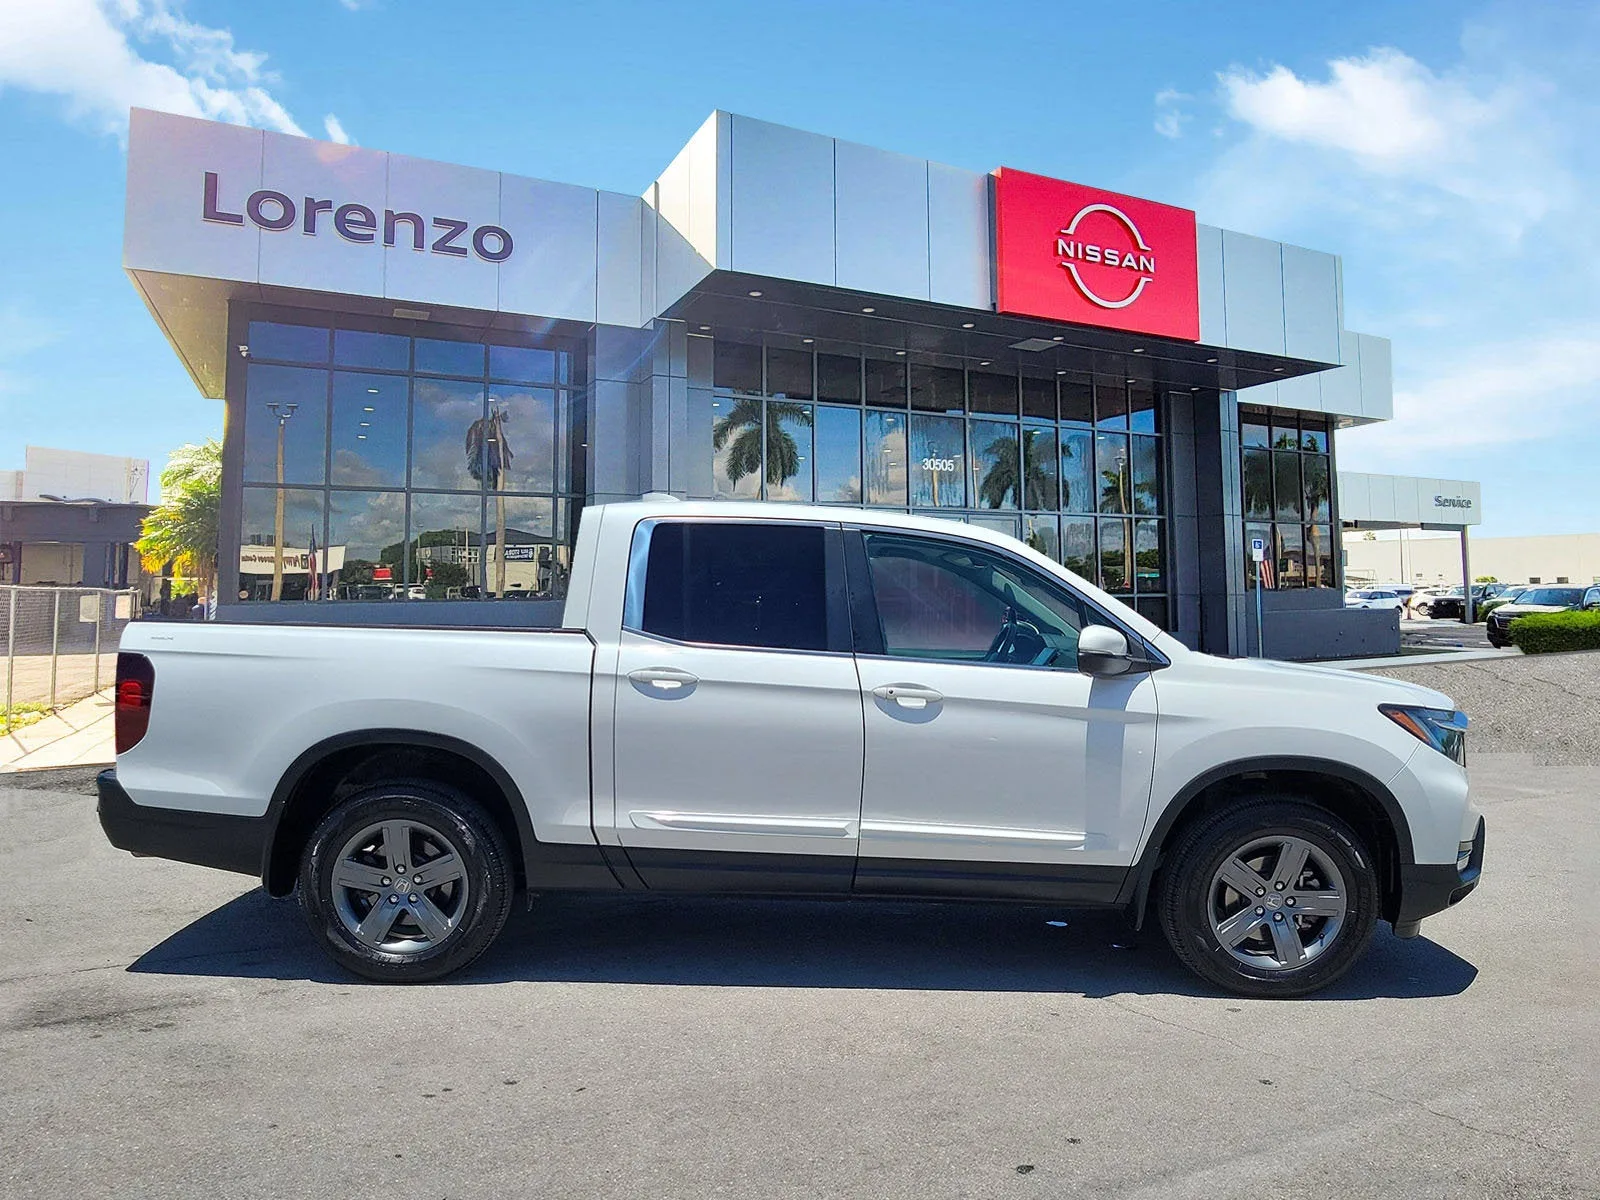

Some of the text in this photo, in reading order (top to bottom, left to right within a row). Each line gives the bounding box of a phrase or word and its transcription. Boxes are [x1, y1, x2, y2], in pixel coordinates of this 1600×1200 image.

[202, 171, 514, 262] Lorenzo
[1057, 238, 1155, 273] NISSAN
[922, 458, 954, 471] 30505
[1434, 495, 1472, 508] Service
